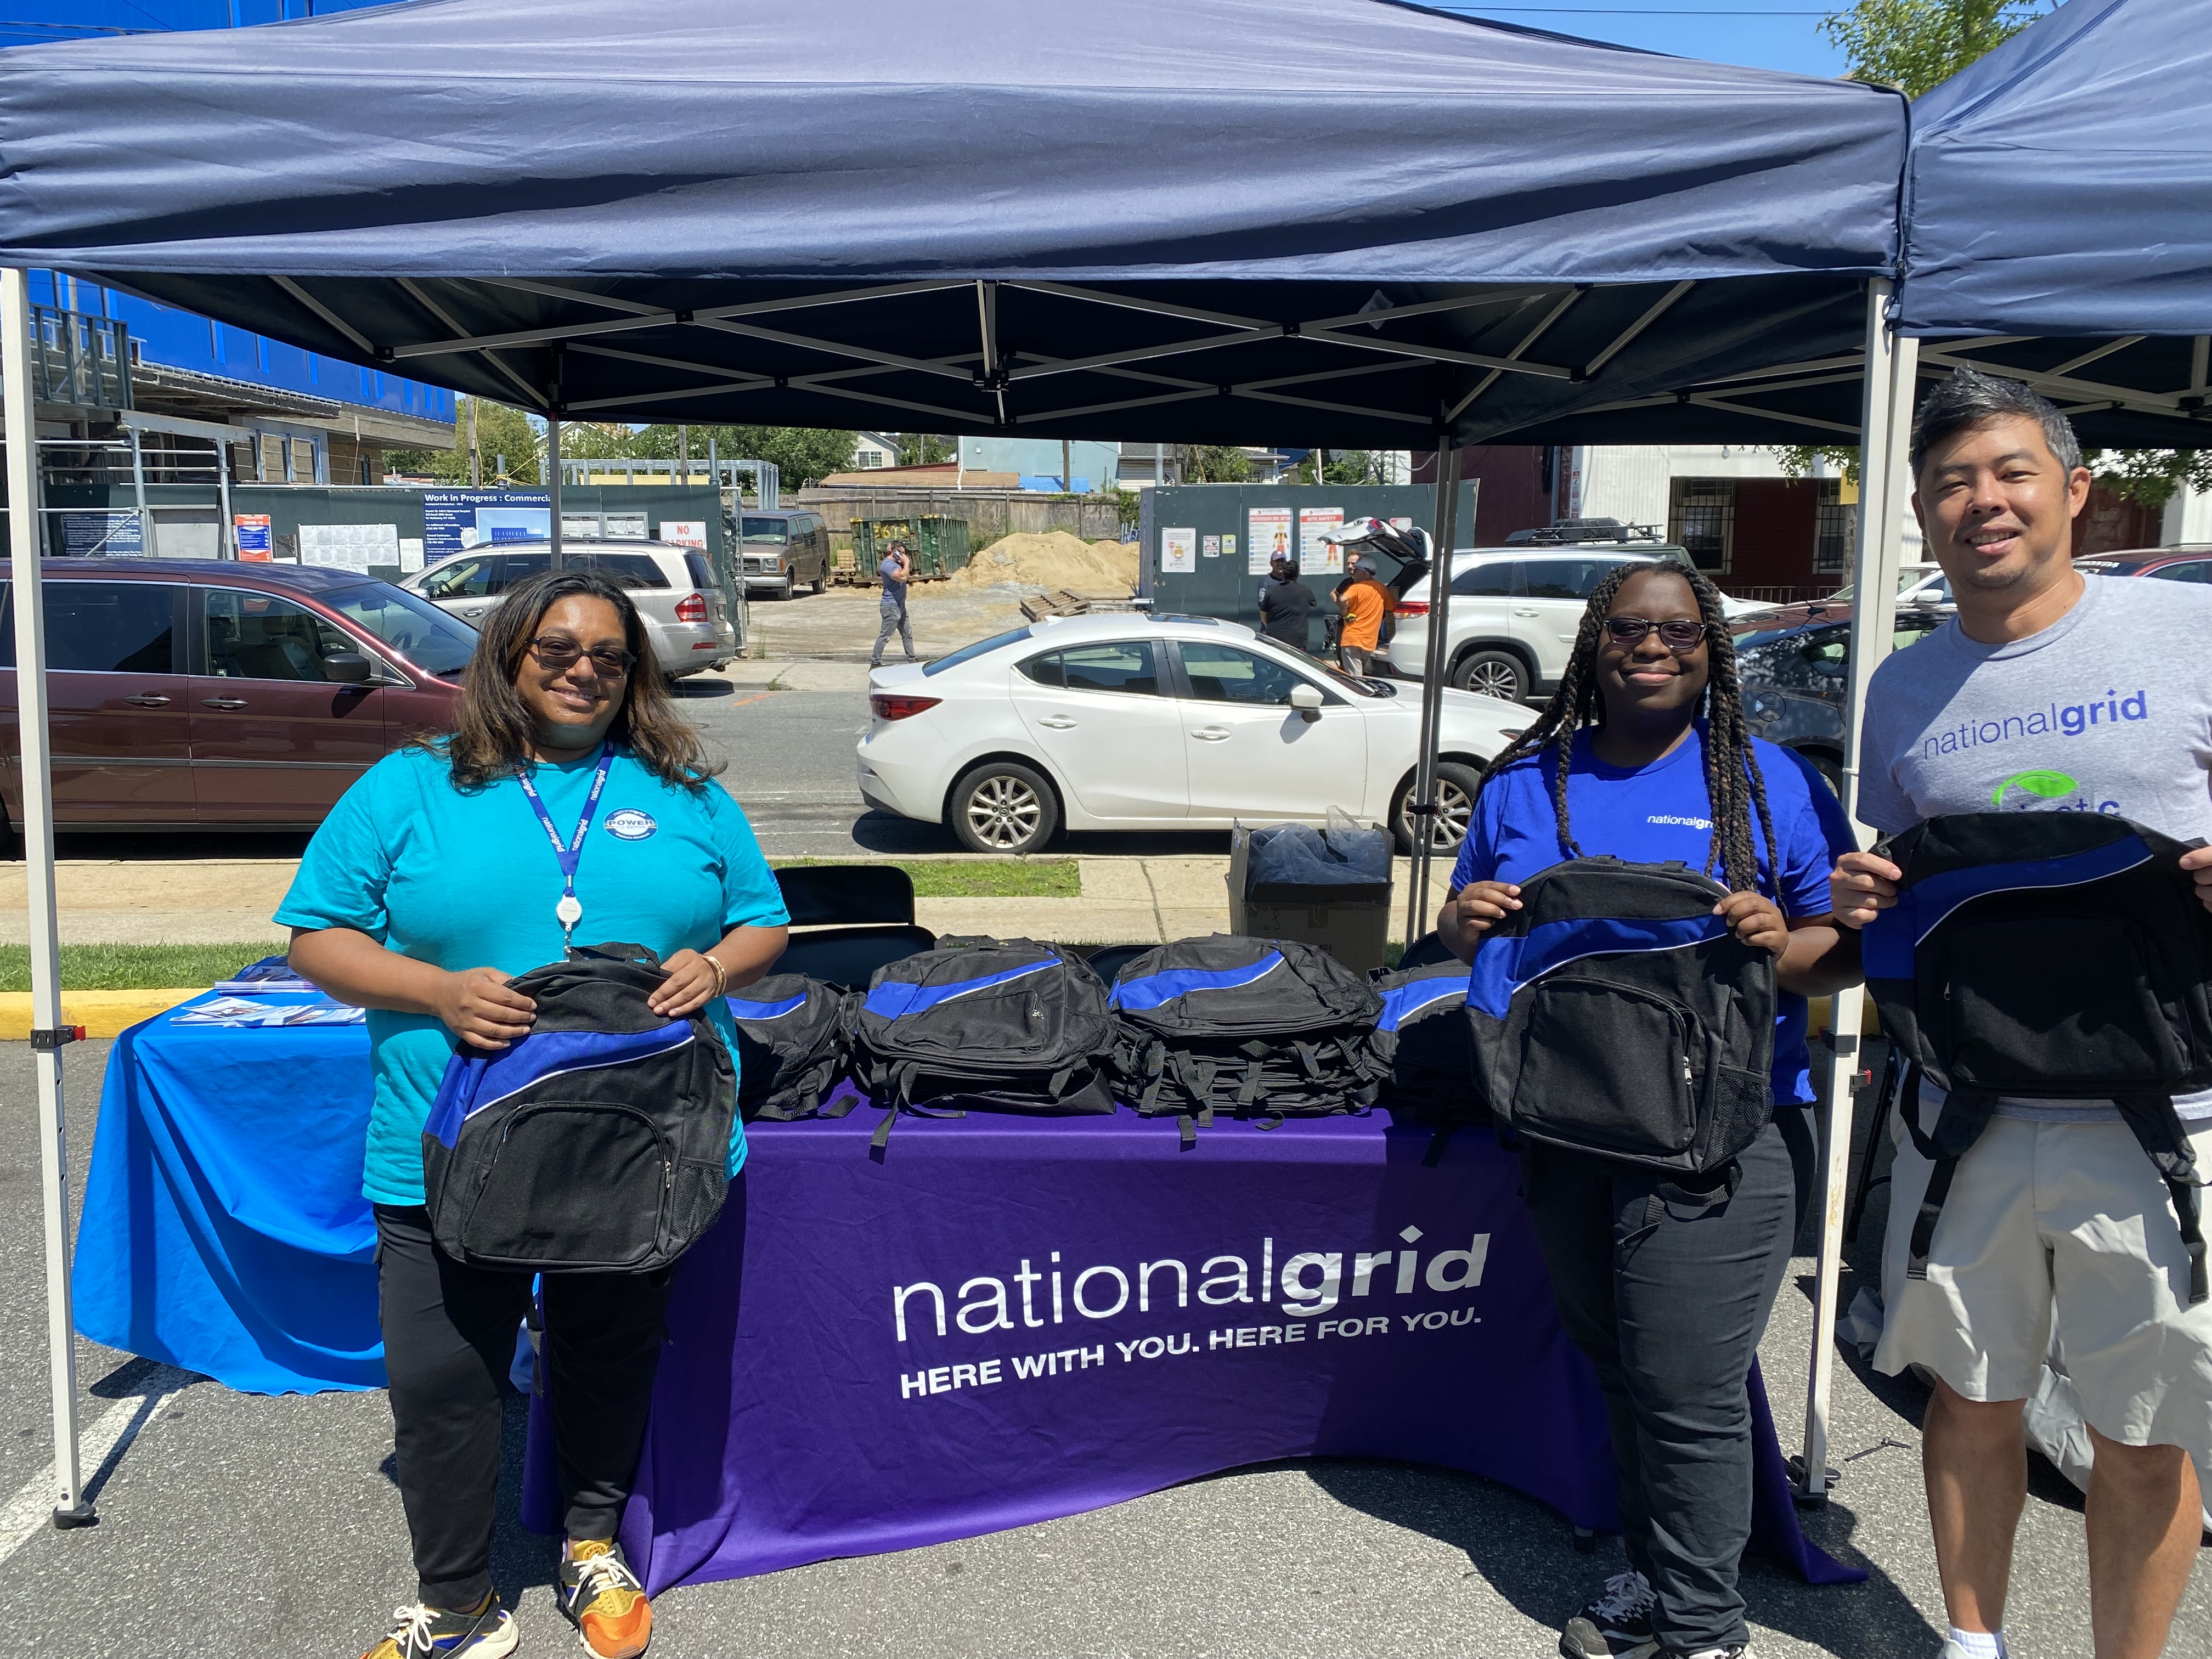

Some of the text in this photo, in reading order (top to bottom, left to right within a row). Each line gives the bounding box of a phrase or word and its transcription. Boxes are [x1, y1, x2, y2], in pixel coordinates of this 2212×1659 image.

[461, 494, 497, 503] Progress
[677, 525, 690, 534] NO
[1924, 690, 2148, 760] nationalgrid
[590, 769, 606, 801] nationalgrid
[542, 817, 566, 852] nationalgrid
[572, 819, 589, 851] nationalgrid
[1647, 815, 1713, 830] nationalgr
[894, 1225, 1491, 1341] nationalgrid
[901, 1307, 1481, 1399] HERE WITH YOU. HERE FOR YOU.
